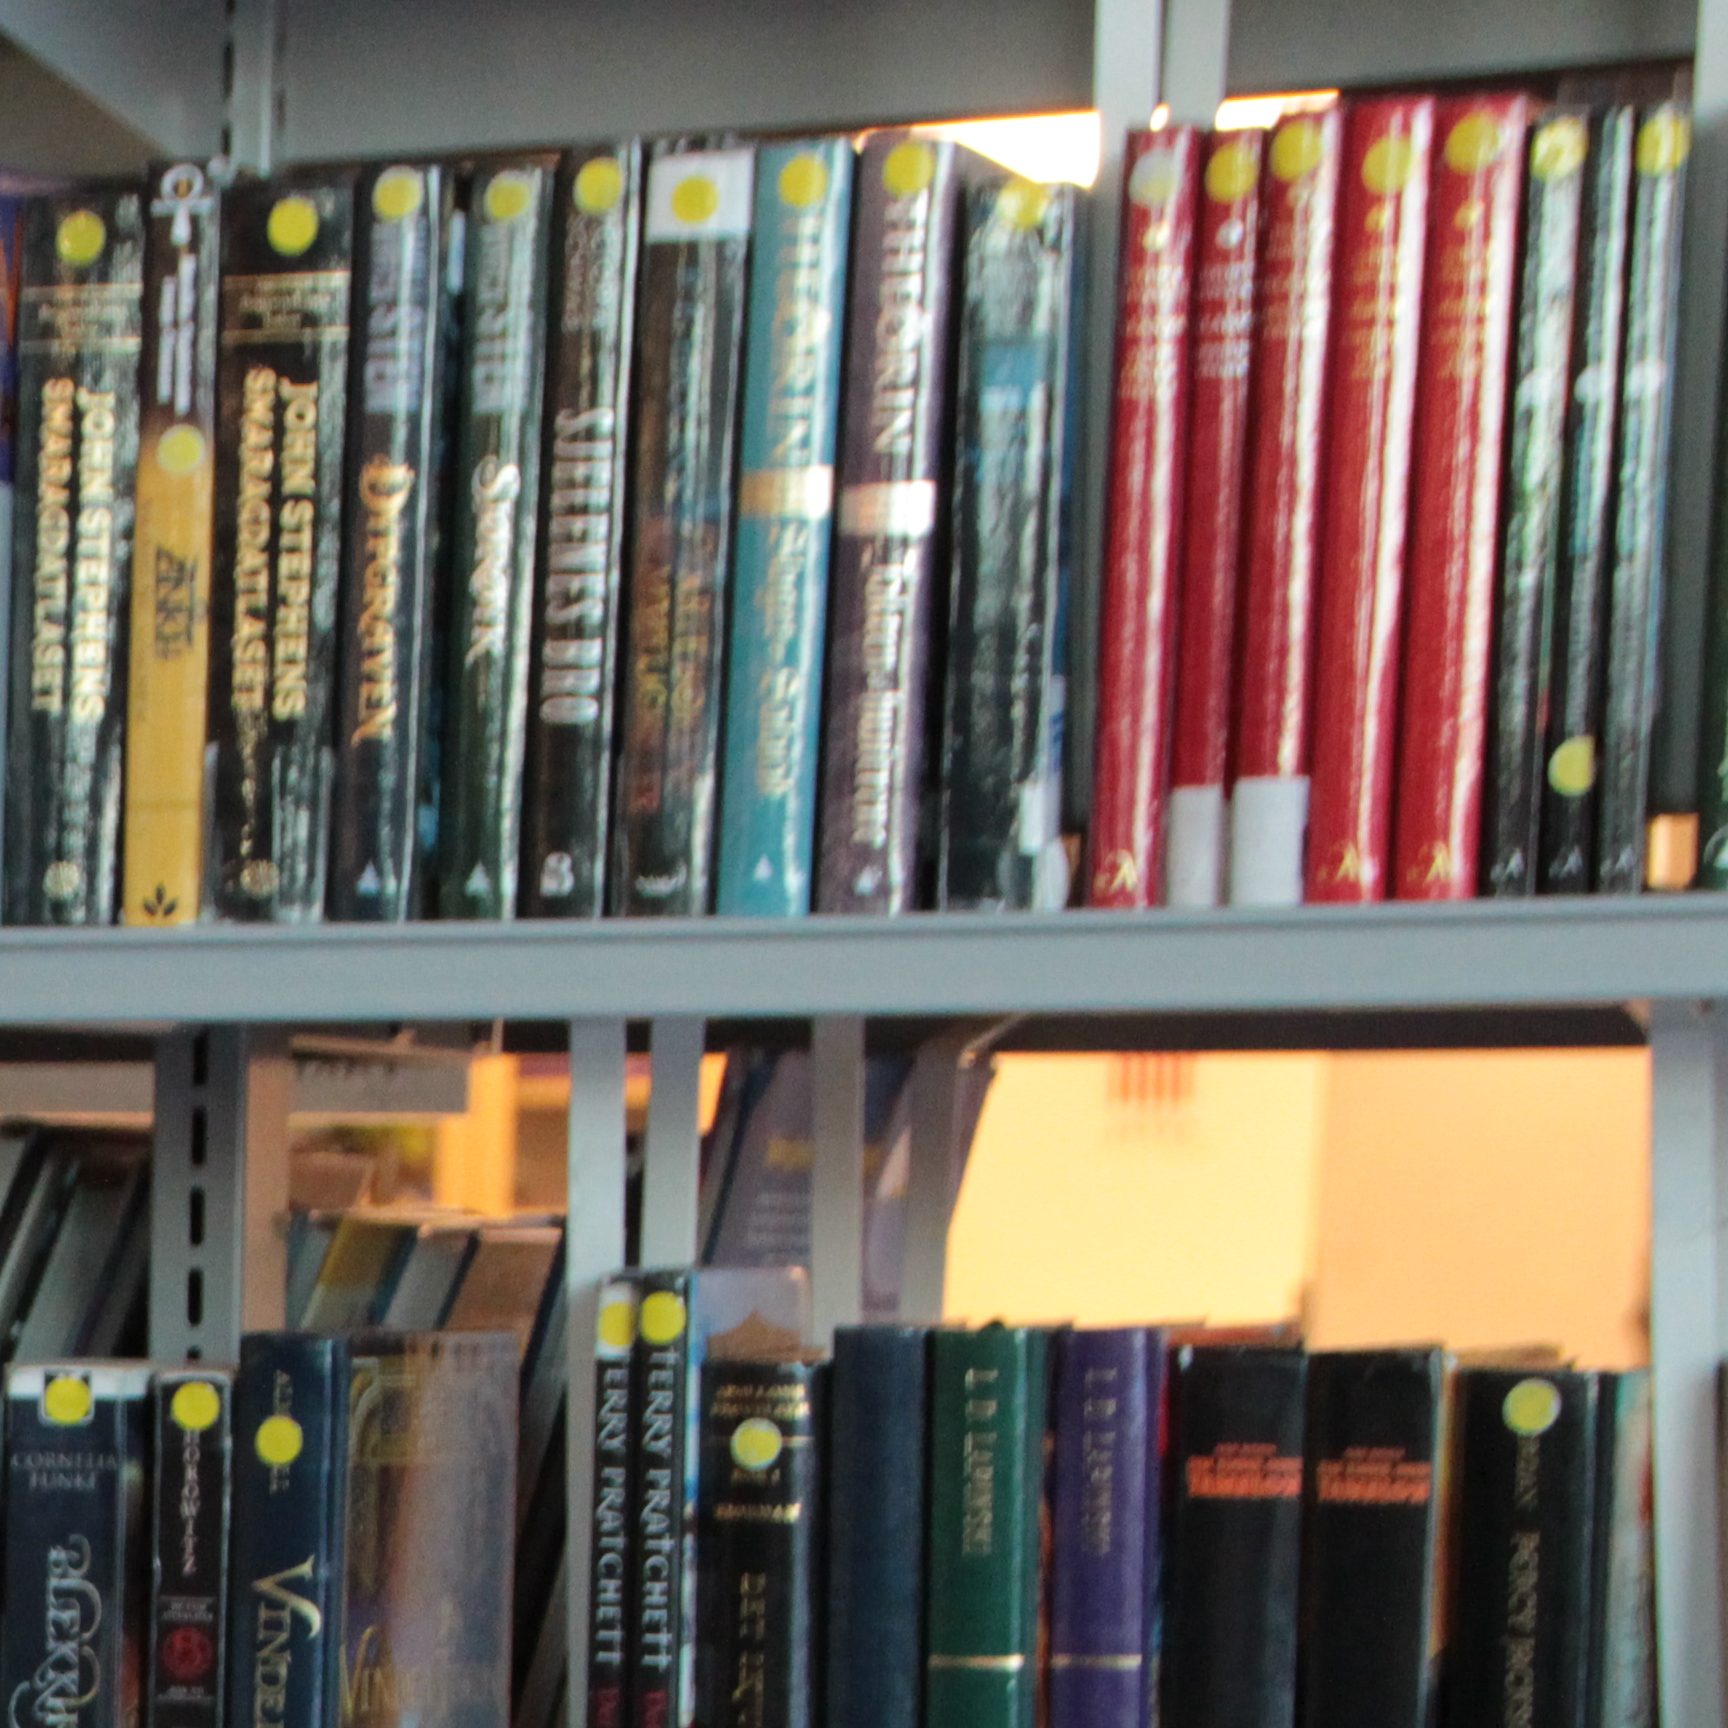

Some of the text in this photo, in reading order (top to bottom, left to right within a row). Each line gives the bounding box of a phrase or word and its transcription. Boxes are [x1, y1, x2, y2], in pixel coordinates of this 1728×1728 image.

[30, 377, 76, 713] SMARAGDATLASET
[69, 385, 114, 723] JOHN STEPHENS
[231, 367, 277, 713] SMARAGDATLASET
[271, 379, 318, 723] JOHN STEPHENS
[11, 1451, 117, 1470] CORNELIA
[27, 1470, 98, 1489] FUNKE
[595, 1462, 627, 1667] PRATCHETT
[638, 1350, 679, 1669] TERRY PRATCHETT
